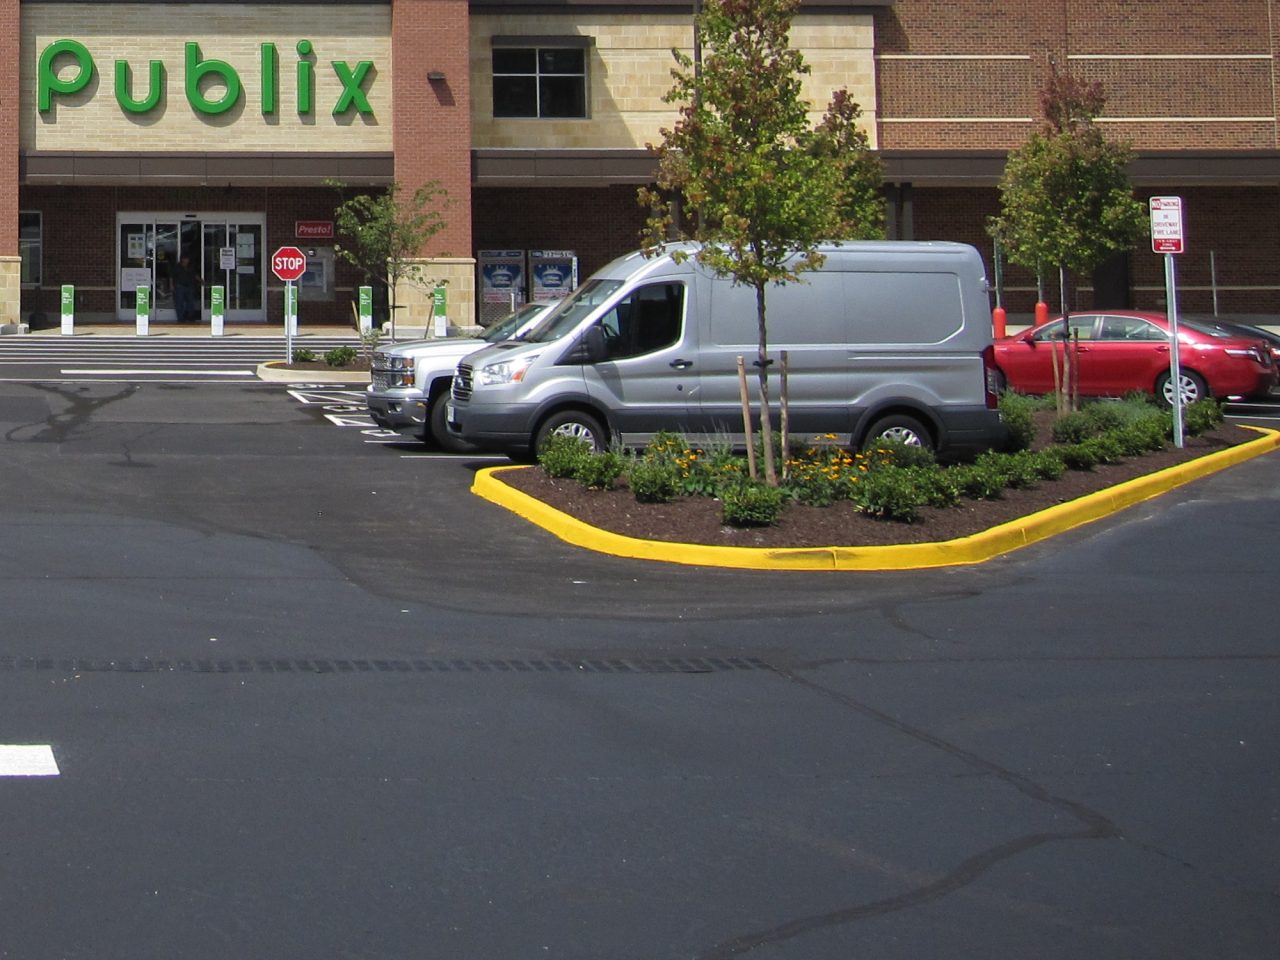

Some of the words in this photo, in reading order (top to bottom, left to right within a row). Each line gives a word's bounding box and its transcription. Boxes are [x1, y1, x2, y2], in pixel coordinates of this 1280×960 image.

[38, 39, 374, 116] Publix
[298, 225, 331, 234] Presto!
[275, 257, 303, 270] STOP
